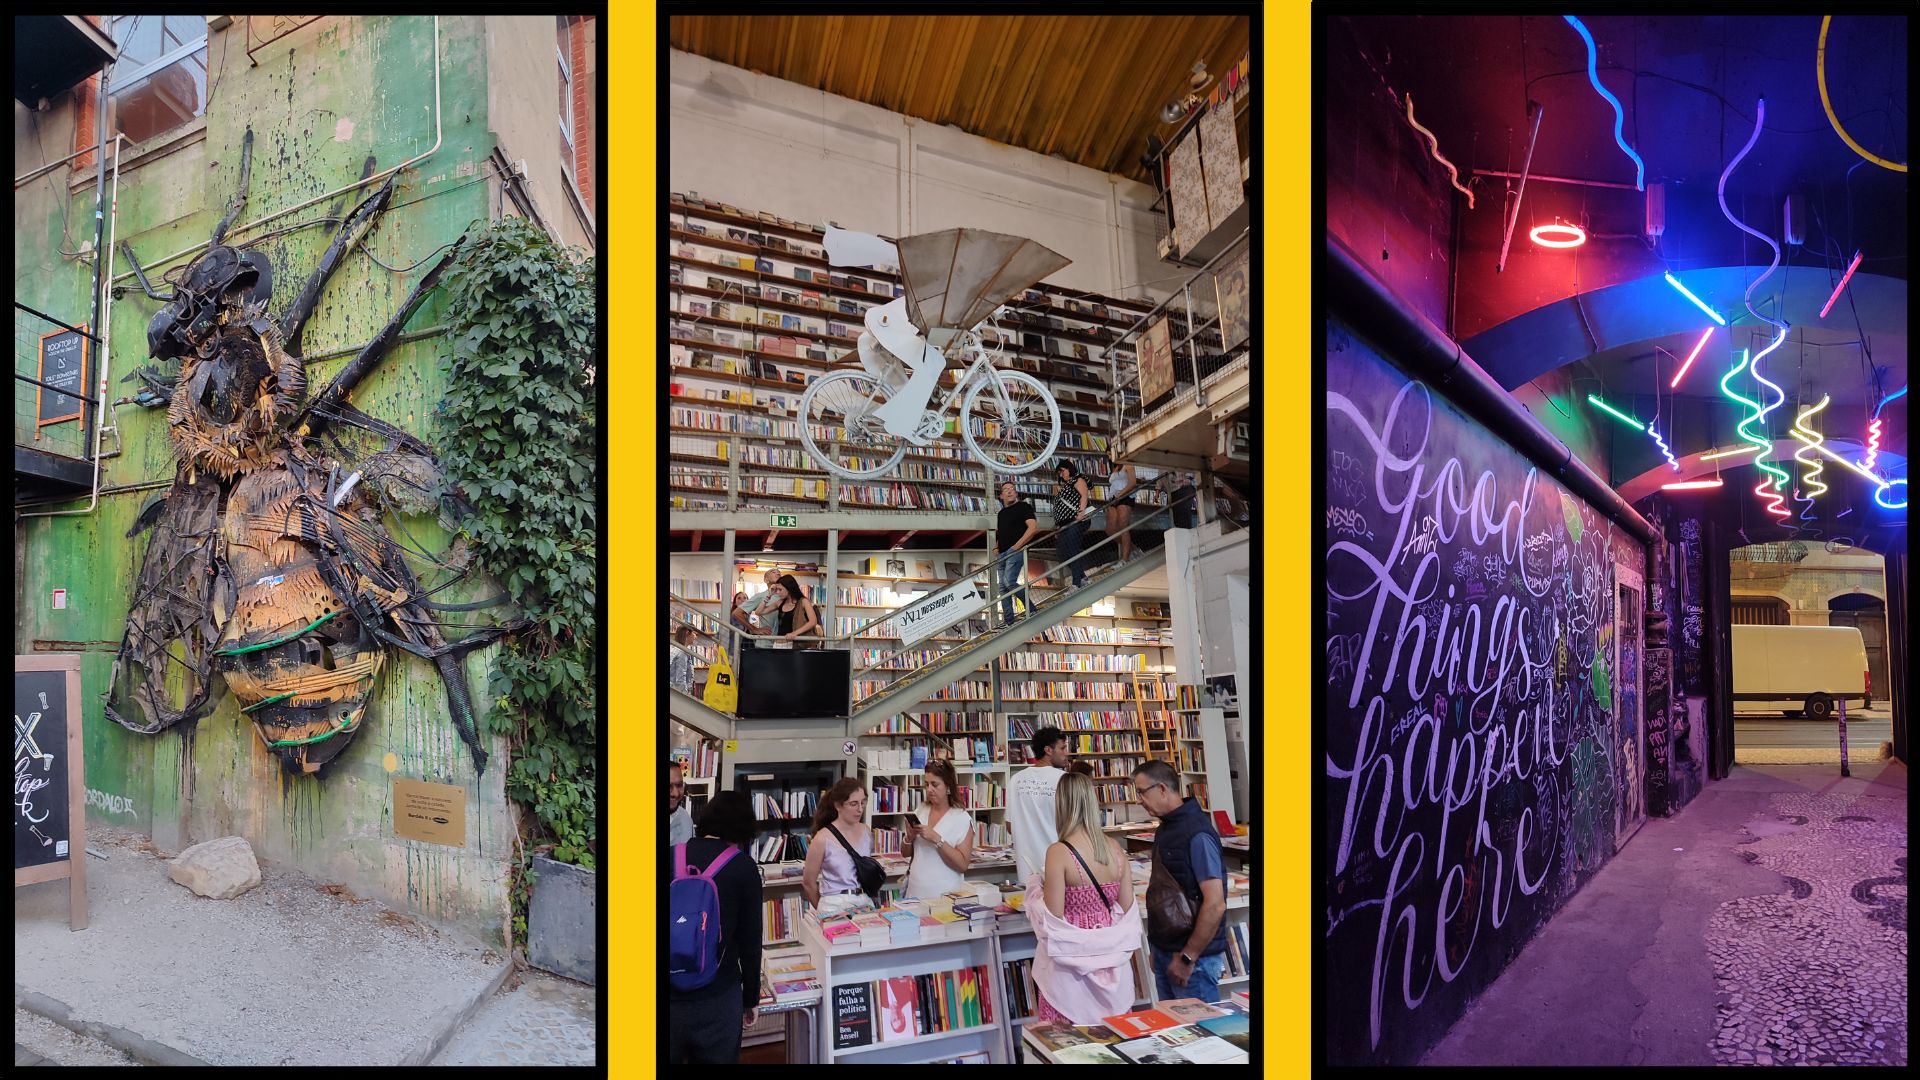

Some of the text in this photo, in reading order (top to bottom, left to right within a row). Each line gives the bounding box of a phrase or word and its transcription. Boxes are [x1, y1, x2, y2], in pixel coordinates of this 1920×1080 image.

[1327, 679, 1571, 880] happen
[84, 786, 123, 813] ORDALO
[1327, 773, 1559, 1051] here
[839, 988, 863, 996] Porque
[839, 996, 858, 1005] falha
[840, 1031, 859, 1040] Ansell
